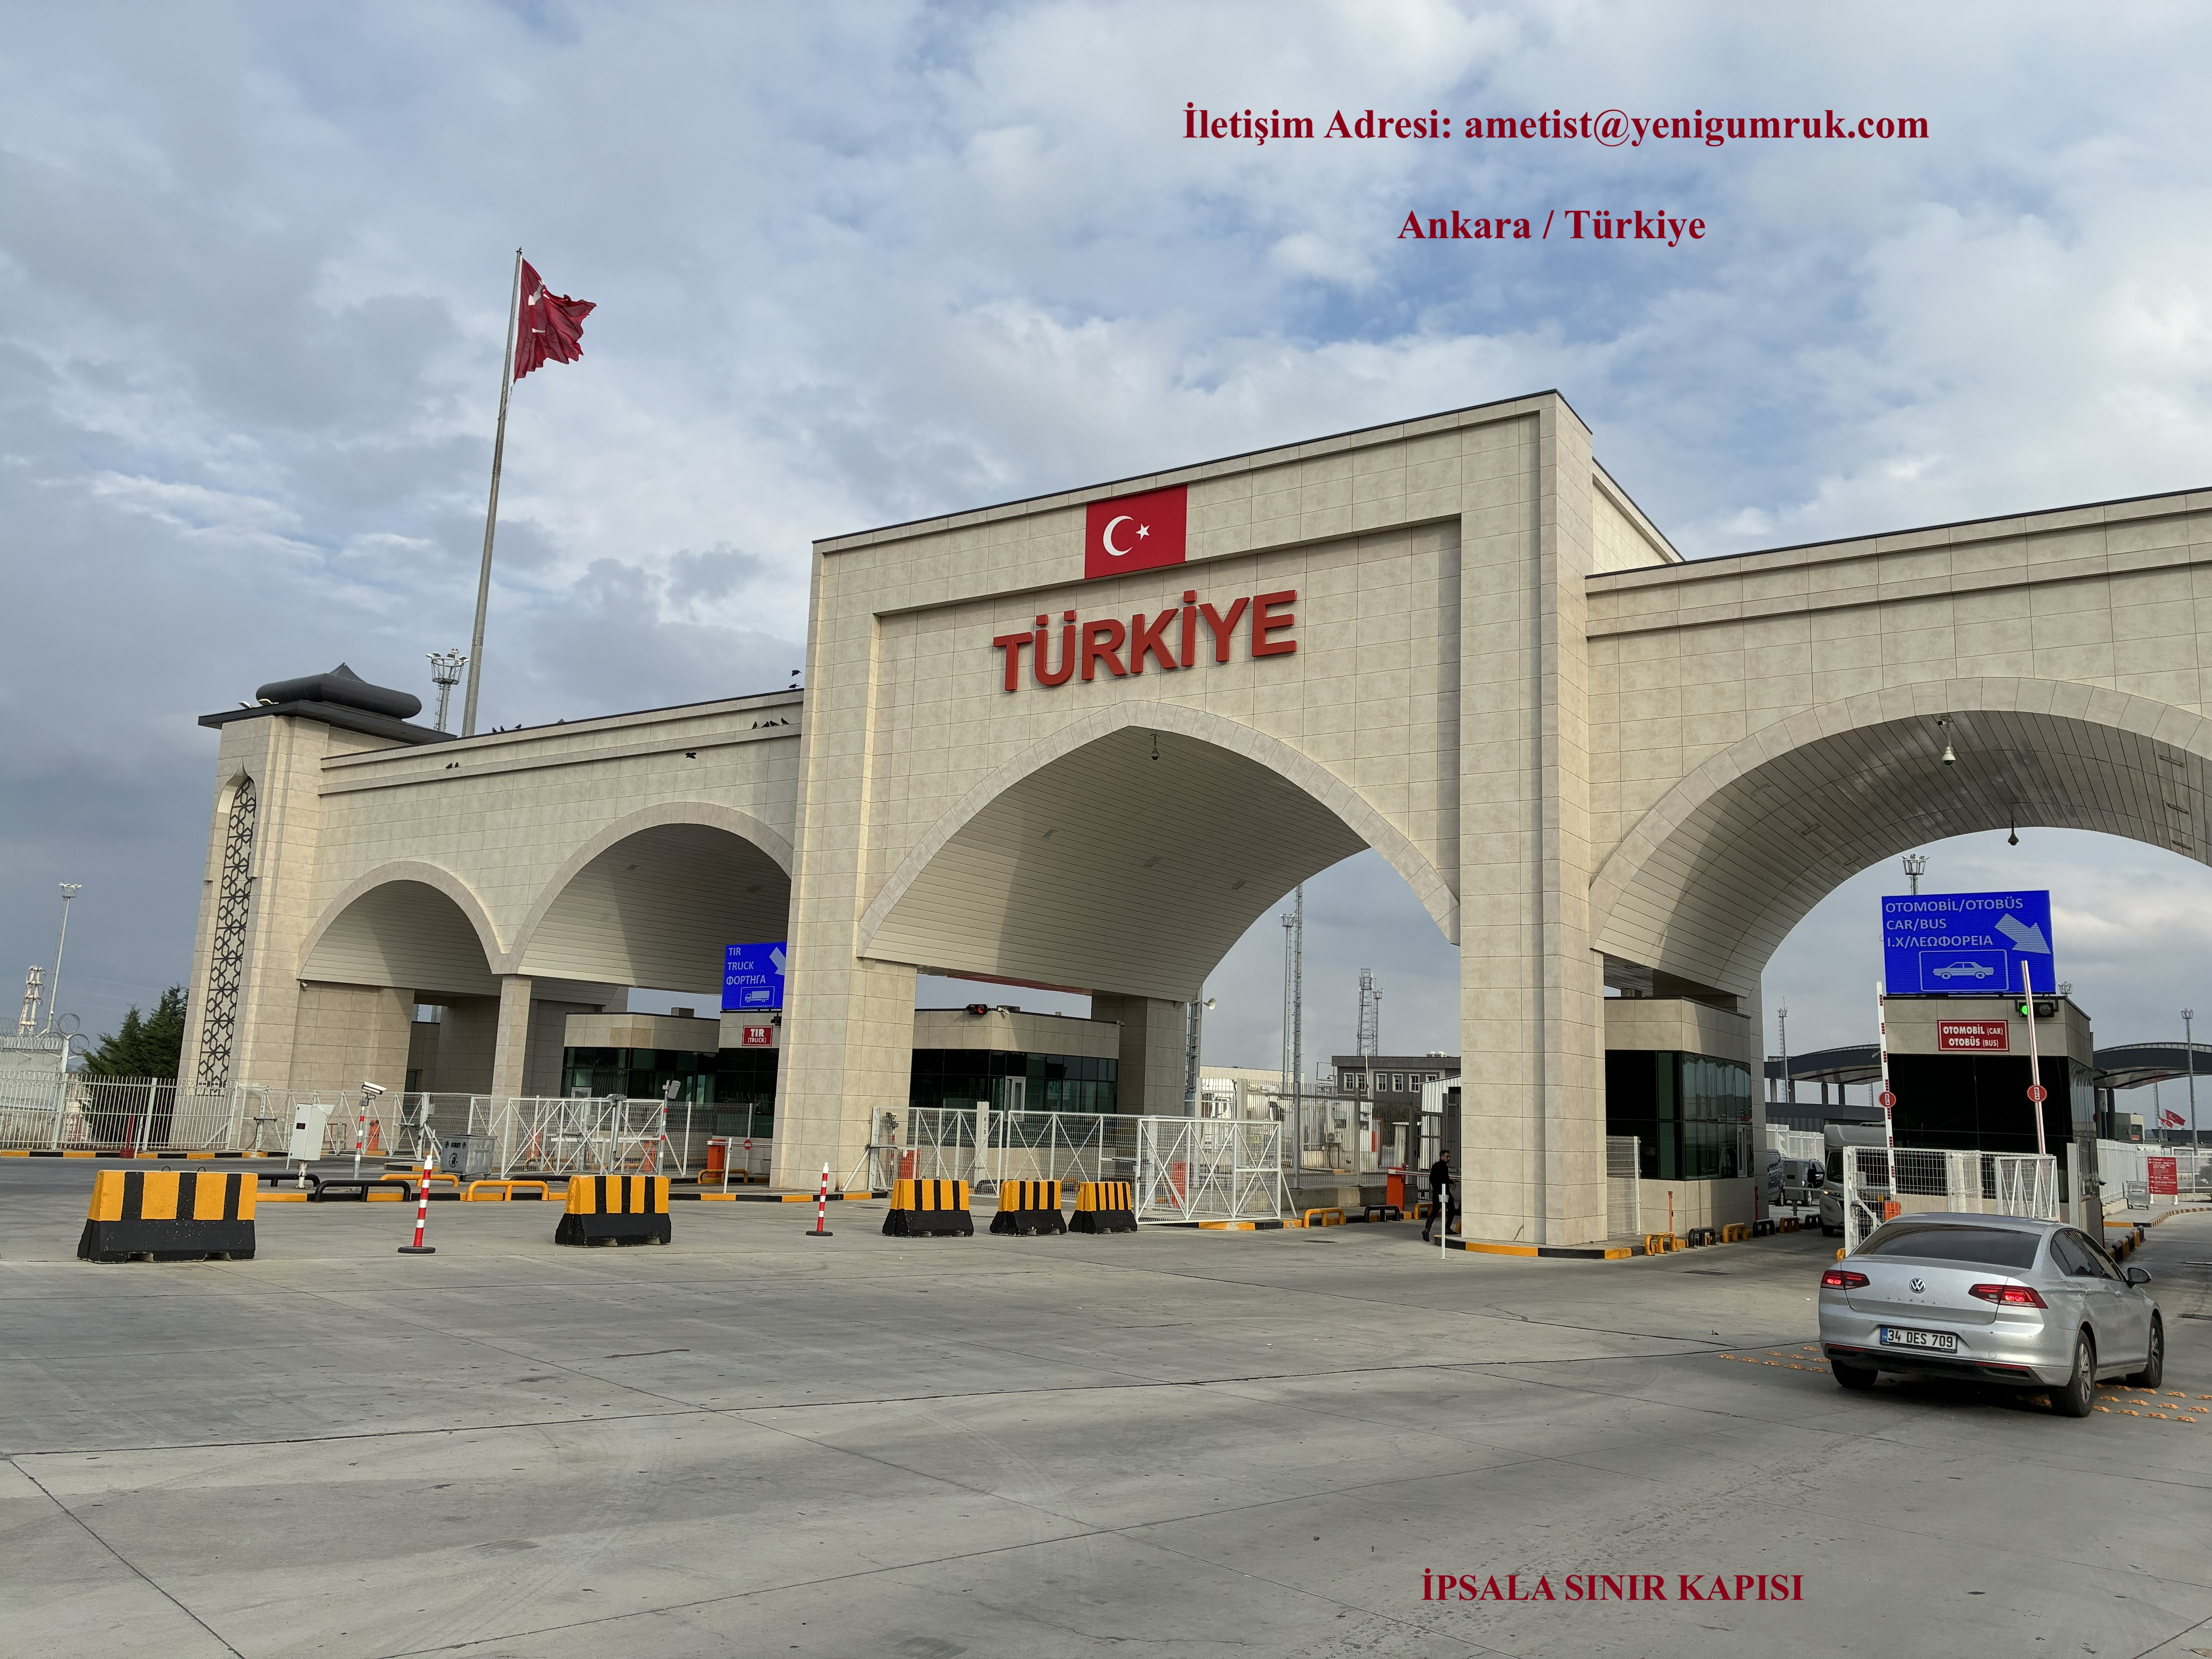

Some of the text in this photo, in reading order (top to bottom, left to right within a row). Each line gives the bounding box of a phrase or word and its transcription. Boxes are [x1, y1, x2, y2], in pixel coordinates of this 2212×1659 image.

[993, 590, 1297, 691] TÜRKİYE
[1885, 896, 2023, 913] OTOMOBİL/OTOBÜS
[1886, 918, 1947, 931] CAR/BUS
[728, 947, 741, 956] TIR
[728, 961, 754, 970] TRUCK
[750, 1028, 764, 1037] TIR
[1943, 1024, 2003, 1036] OTOMOBİL (CAR)
[1949, 1036, 1999, 1048] OTOBÜS (BUS)
[1910, 1278, 1925, 1293] VW
[1888, 1329, 1953, 1348] 34 DES 709
